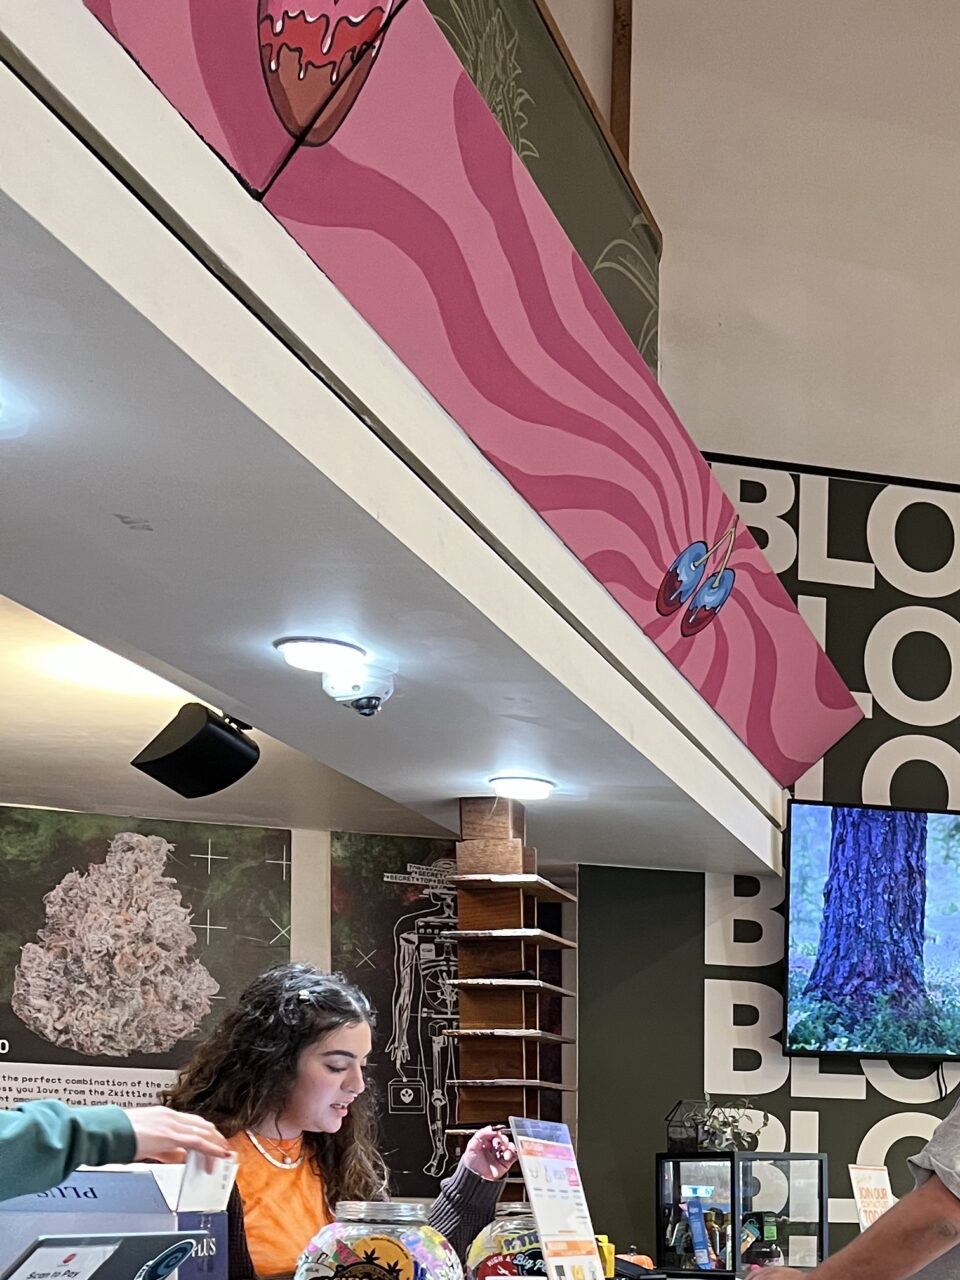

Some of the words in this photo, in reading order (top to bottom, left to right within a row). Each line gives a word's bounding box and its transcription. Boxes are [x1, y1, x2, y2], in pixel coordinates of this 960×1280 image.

[2, 1074, 19, 1082] the
[22, 1076, 62, 1084] perfect
[65, 1078, 128, 1087] combination
[146, 1081, 161, 1089] the
[37, 1086, 59, 1094] love
[108, 1090, 153, 1098] Zkittles
[66, 1098, 87, 1106] fuel
[513, 1253, 534, 1270] Big
[26, 1270, 51, 1280] Scan
[52, 1270, 61, 1279] to
[61, 1269, 80, 1280] Pay
